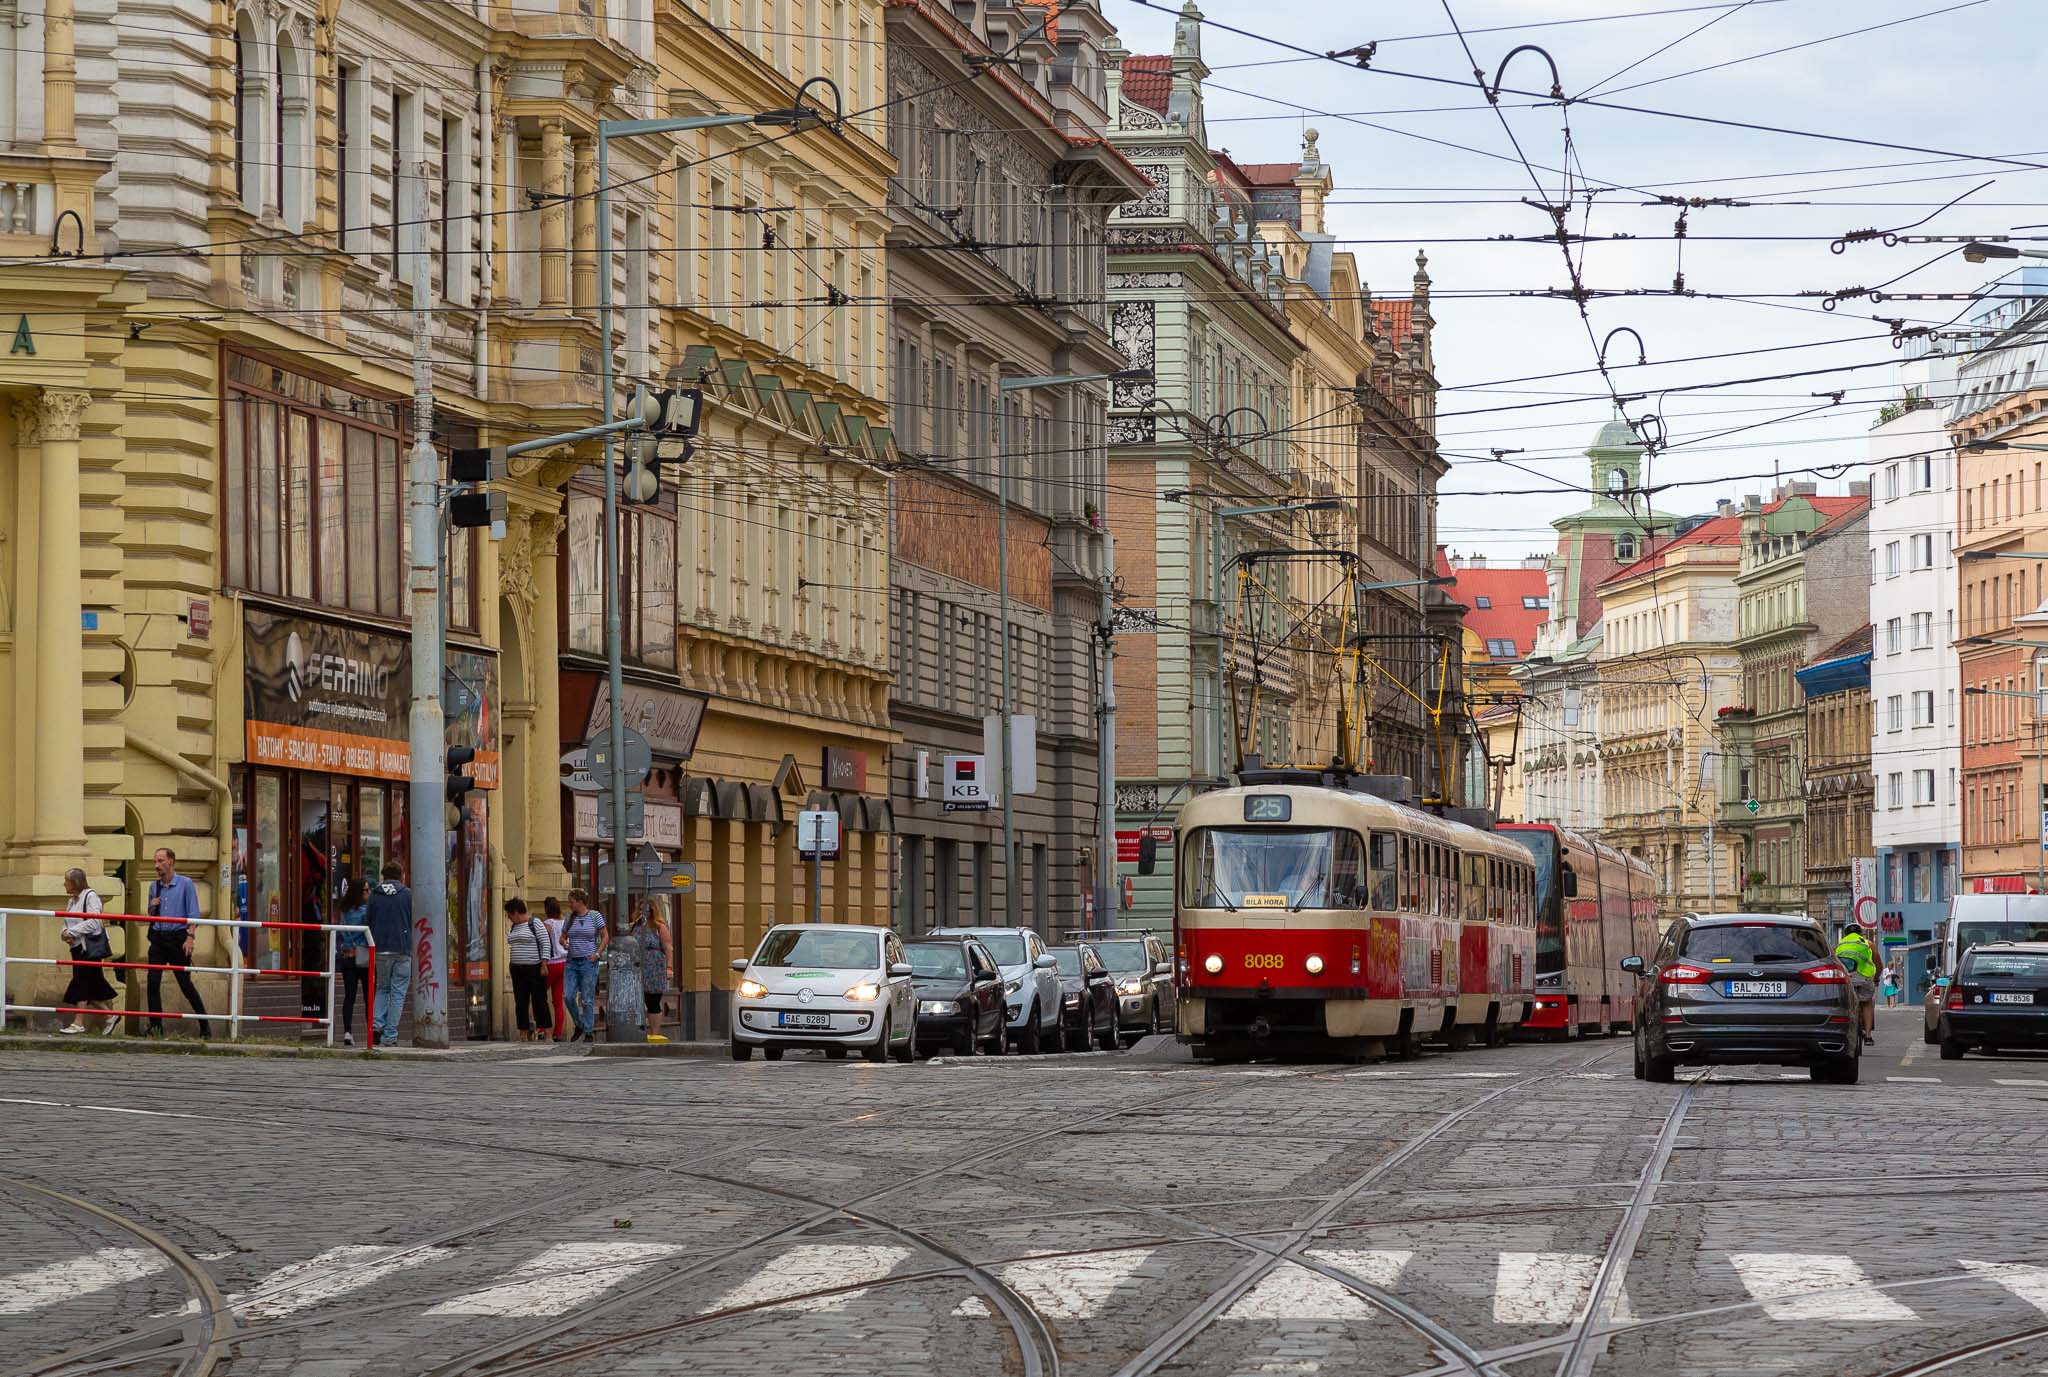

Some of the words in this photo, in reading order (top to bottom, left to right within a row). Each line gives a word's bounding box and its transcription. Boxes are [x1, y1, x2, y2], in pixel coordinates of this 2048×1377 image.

[306, 653, 389, 699] FERRINO
[257, 736, 283, 759] BATOHY
[288, 737, 317, 763] SPACÁKY
[321, 744, 341, 766] STANY
[345, 744, 375, 770] OBLEČENÍ
[951, 785, 980, 796] KB
[1252, 799, 1281, 817] 25
[1264, 898, 1284, 906] HORA
[1244, 953, 1284, 969] 8088
[1733, 982, 1751, 993] 5AL
[1758, 982, 1782, 993] 7618
[785, 1012, 800, 1024] 5AE
[806, 1013, 826, 1025] 6289
